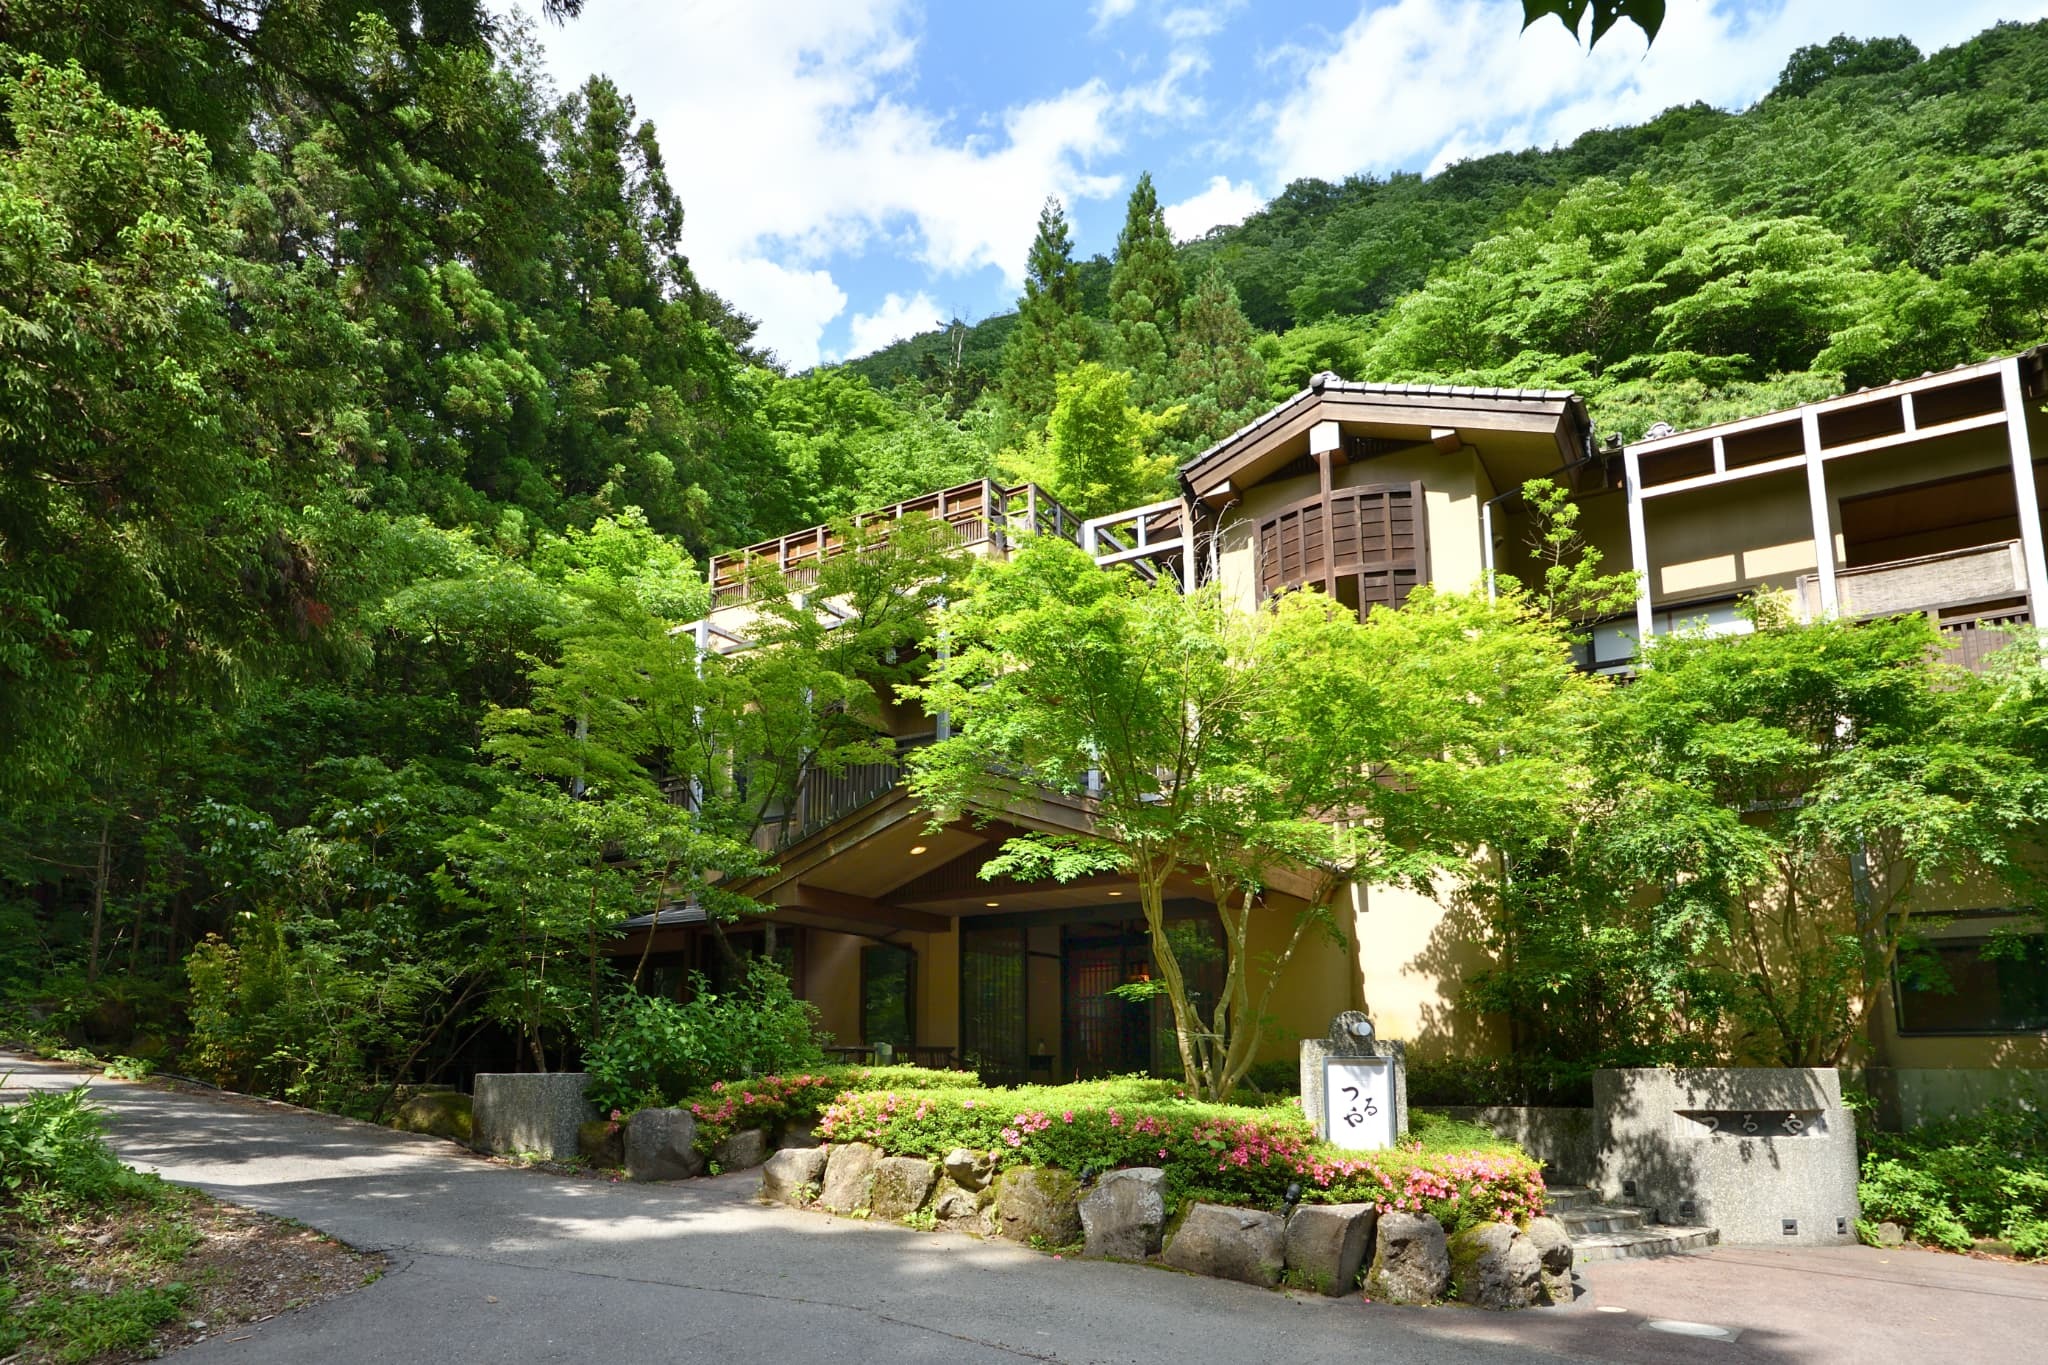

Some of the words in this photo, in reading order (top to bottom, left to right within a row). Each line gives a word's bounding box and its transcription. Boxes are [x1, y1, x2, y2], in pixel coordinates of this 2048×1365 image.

[1341, 1086, 1378, 1127] つるや
[1700, 1113, 1805, 1134] つるや
